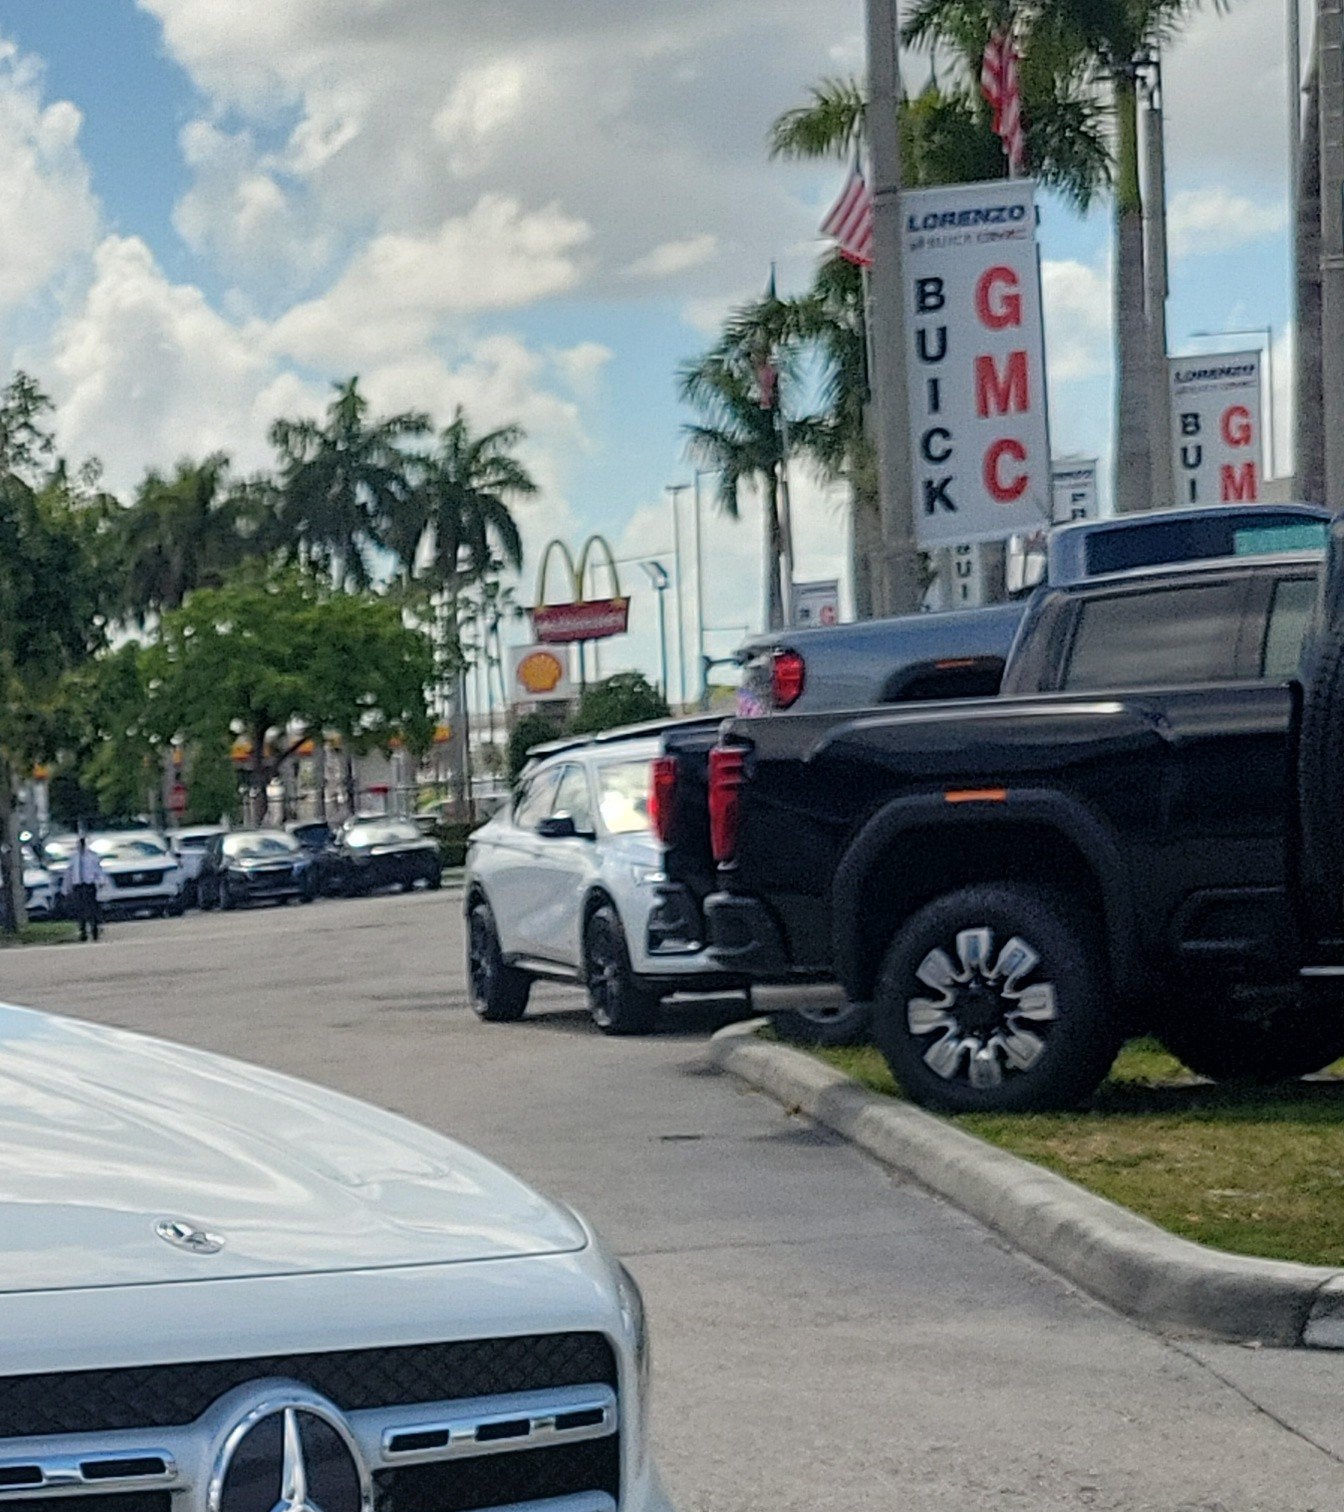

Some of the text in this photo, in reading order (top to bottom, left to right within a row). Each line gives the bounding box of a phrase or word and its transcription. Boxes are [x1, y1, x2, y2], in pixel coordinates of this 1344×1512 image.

[908, 205, 1025, 232] LORENZO
[915, 276, 957, 516] BUICK
[975, 265, 1030, 504] GMC
